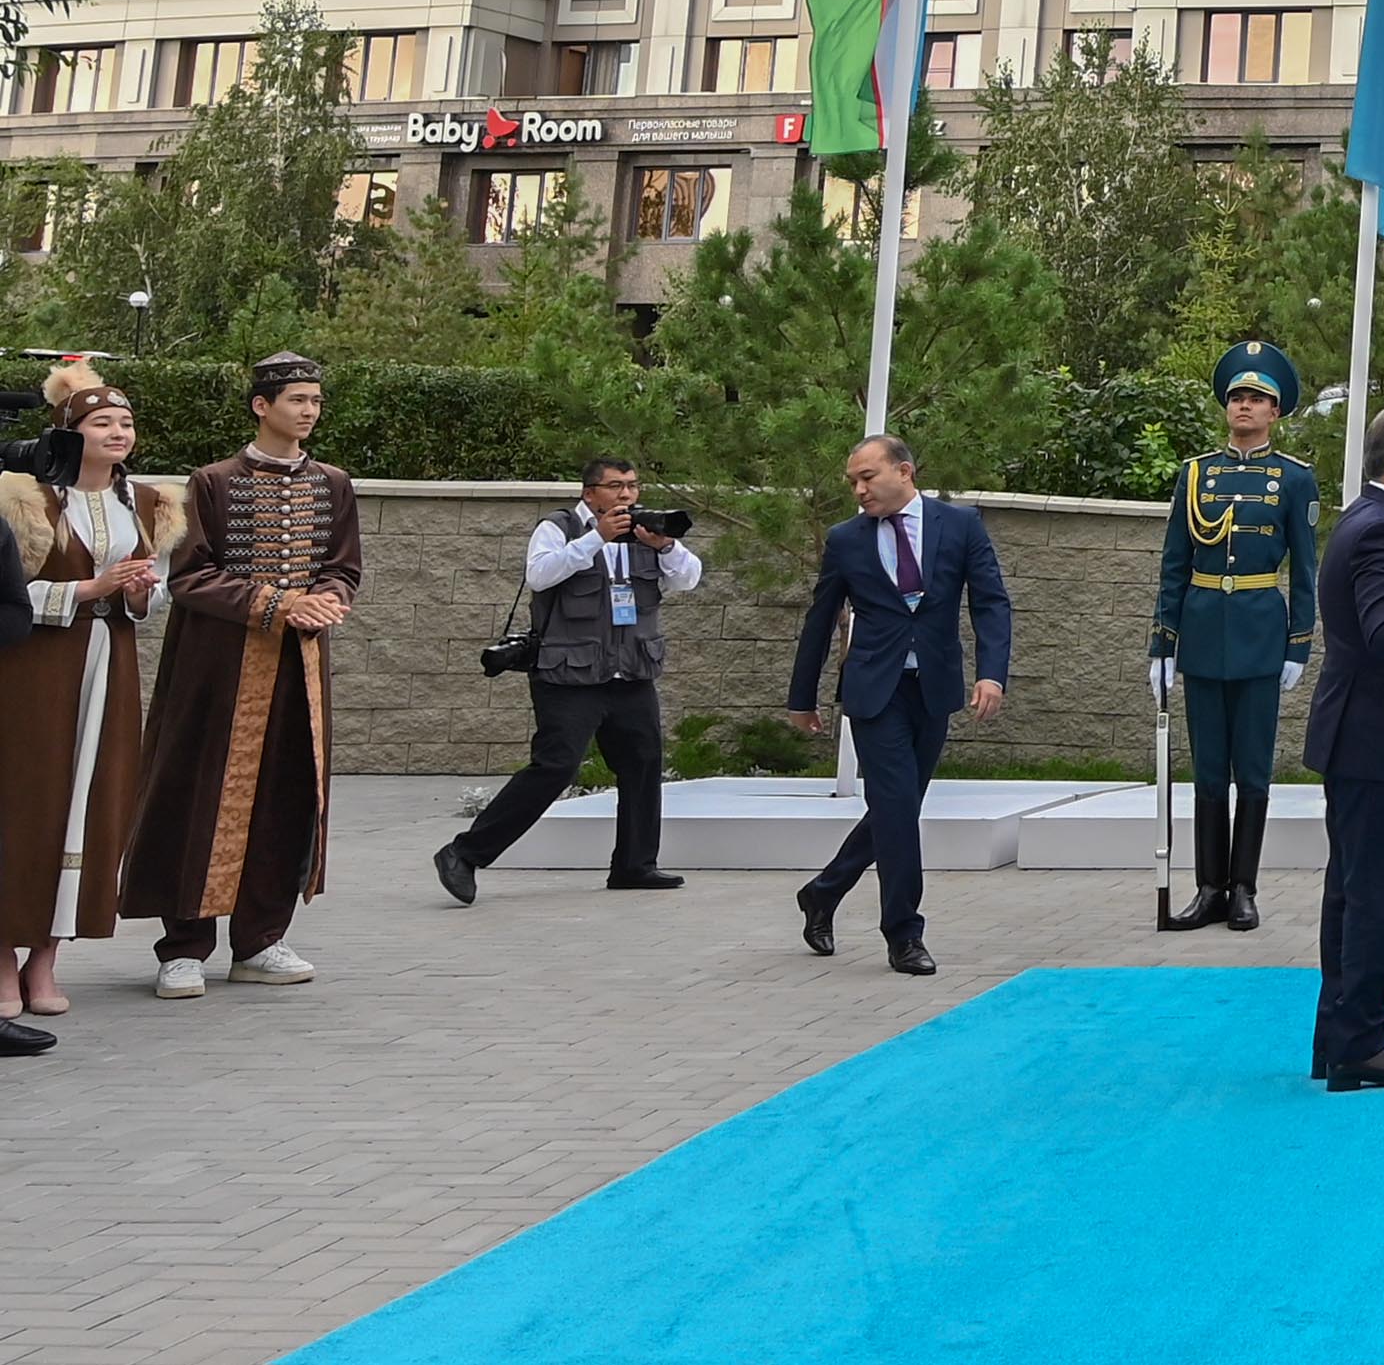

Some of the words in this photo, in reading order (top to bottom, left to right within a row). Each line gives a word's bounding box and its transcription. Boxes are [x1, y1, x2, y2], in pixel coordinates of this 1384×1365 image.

[702, 118, 737, 130] товары
[407, 113, 480, 153] Baby
[521, 111, 602, 144] Room
[631, 132, 651, 142] для
[652, 131, 689, 141] вашего
[691, 130, 733, 140] малыша
